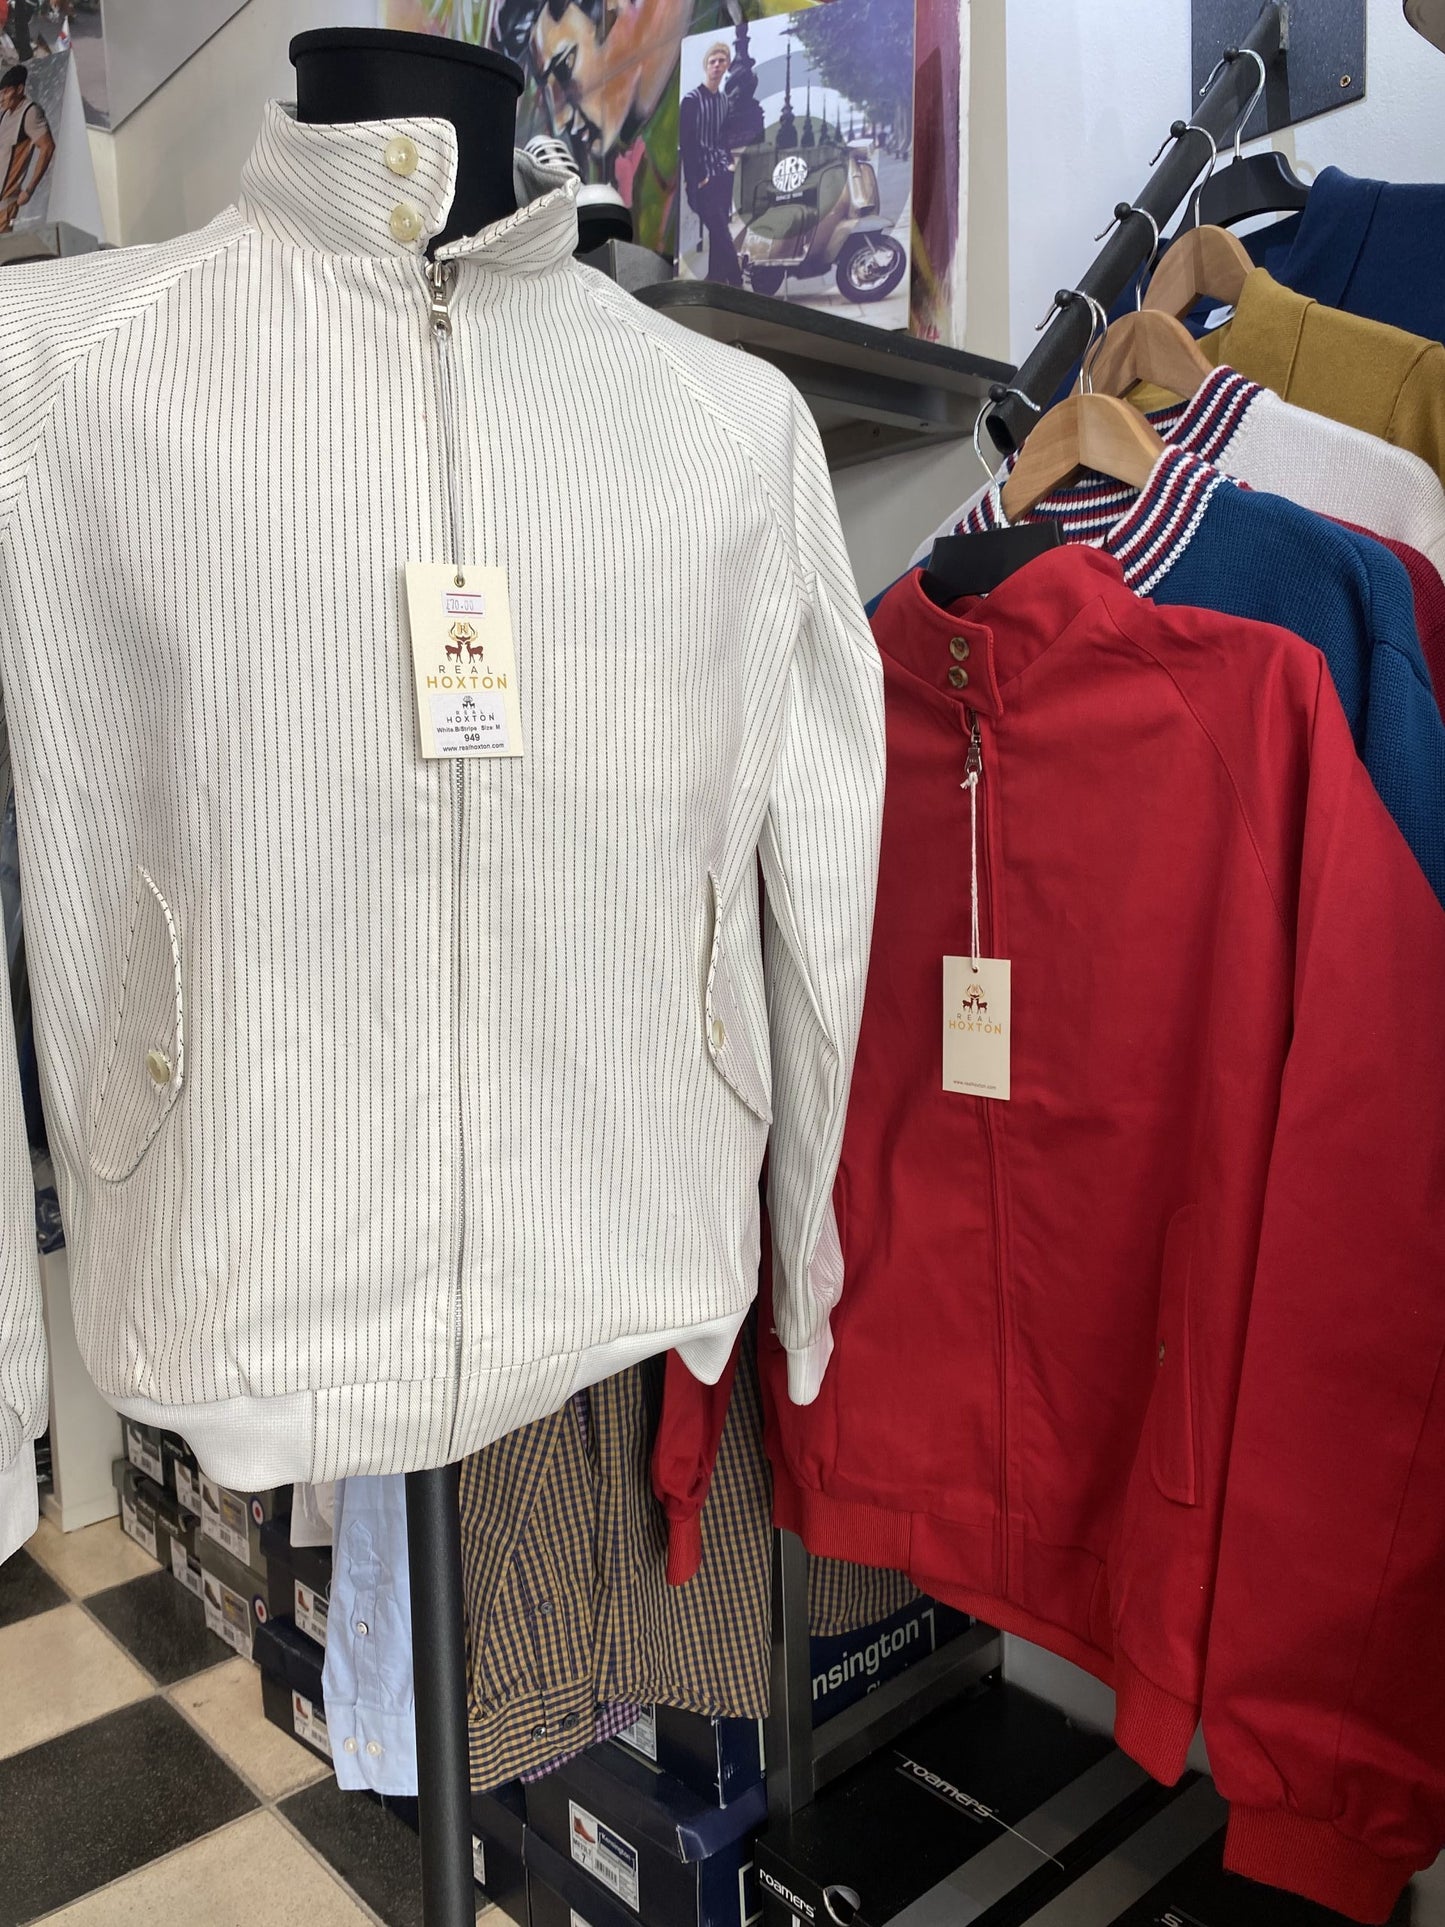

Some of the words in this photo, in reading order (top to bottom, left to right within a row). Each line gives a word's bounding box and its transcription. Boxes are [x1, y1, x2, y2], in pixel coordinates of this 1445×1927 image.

[446, 598, 474, 611] £70.00
[438, 665, 493, 675] REAL
[426, 675, 507, 689] HOXTON
[446, 714, 495, 723] HOXTON
[464, 733, 481, 742] 949
[442, 742, 505, 753] www.realhoxton.com
[957, 1013, 992, 1023] REAL
[948, 1020, 1002, 1035] HOXTON
[901, 1759, 993, 1818] roamers
[759, 1868, 815, 1918] roamers
